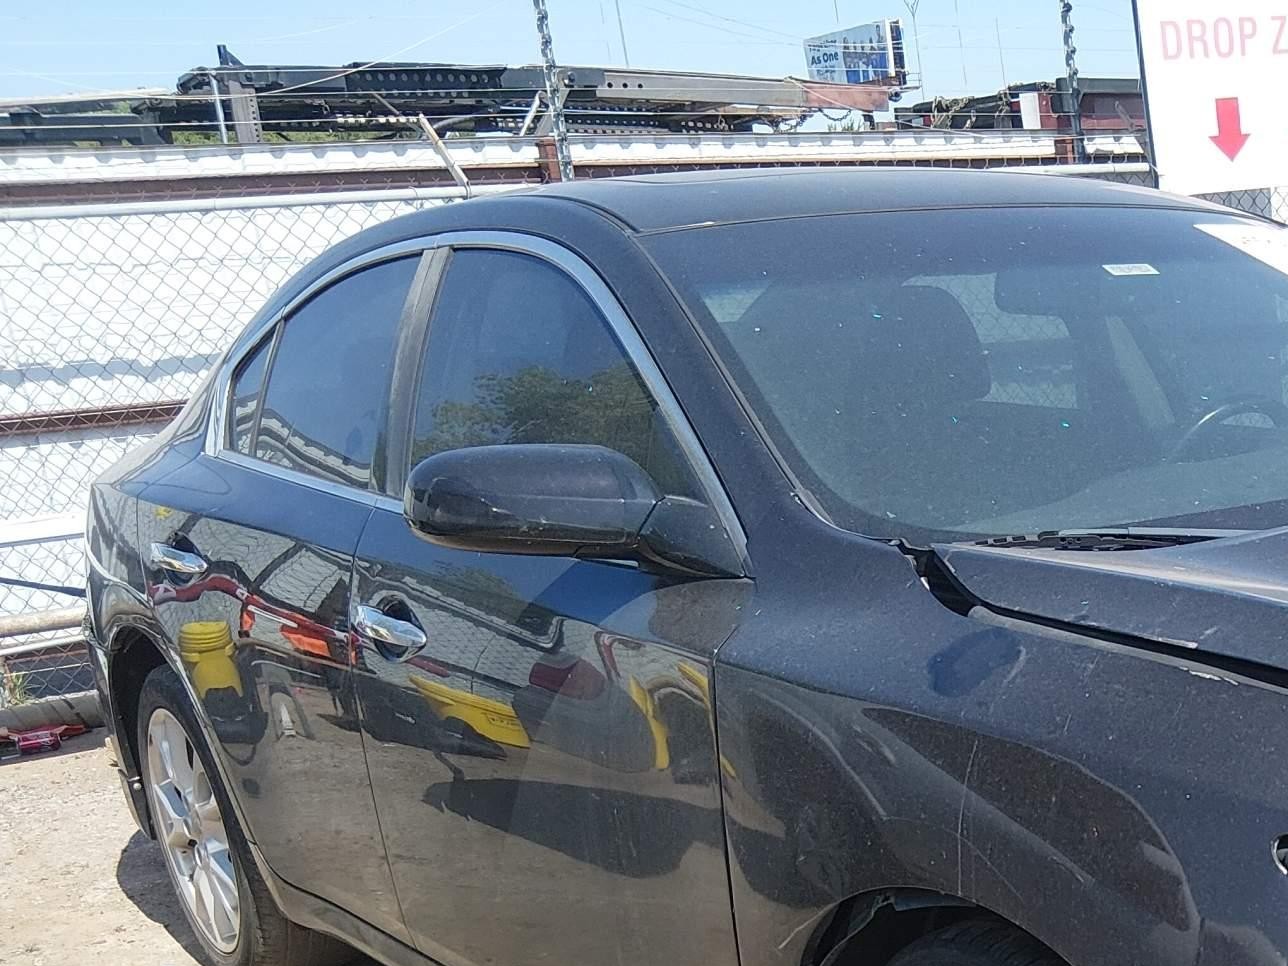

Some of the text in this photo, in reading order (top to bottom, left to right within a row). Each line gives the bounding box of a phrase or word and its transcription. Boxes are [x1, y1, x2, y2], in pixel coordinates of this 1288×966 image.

[1160, 16, 1258, 61] DROP
[811, 51, 839, 66] As One
